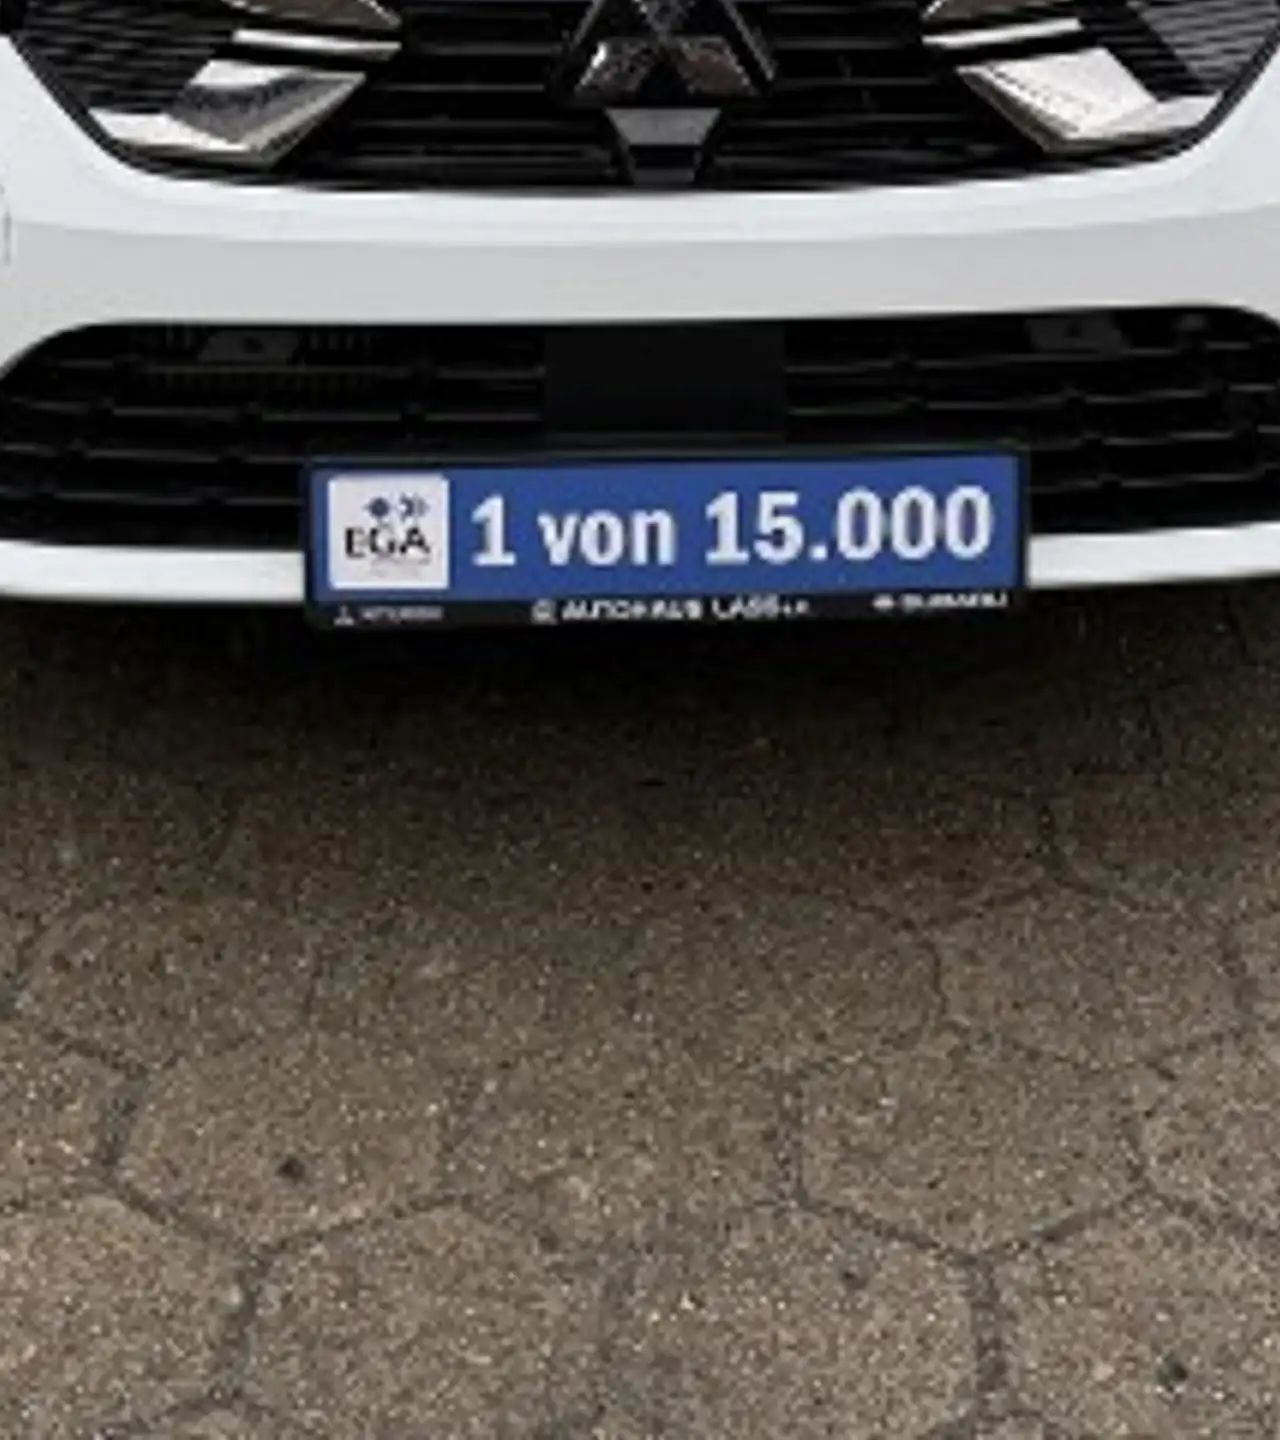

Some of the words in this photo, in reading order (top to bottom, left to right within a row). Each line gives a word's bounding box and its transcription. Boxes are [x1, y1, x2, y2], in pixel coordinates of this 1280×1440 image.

[471, 495, 517, 566] 1
[537, 508, 678, 566] von
[705, 485, 994, 563] 15.000
